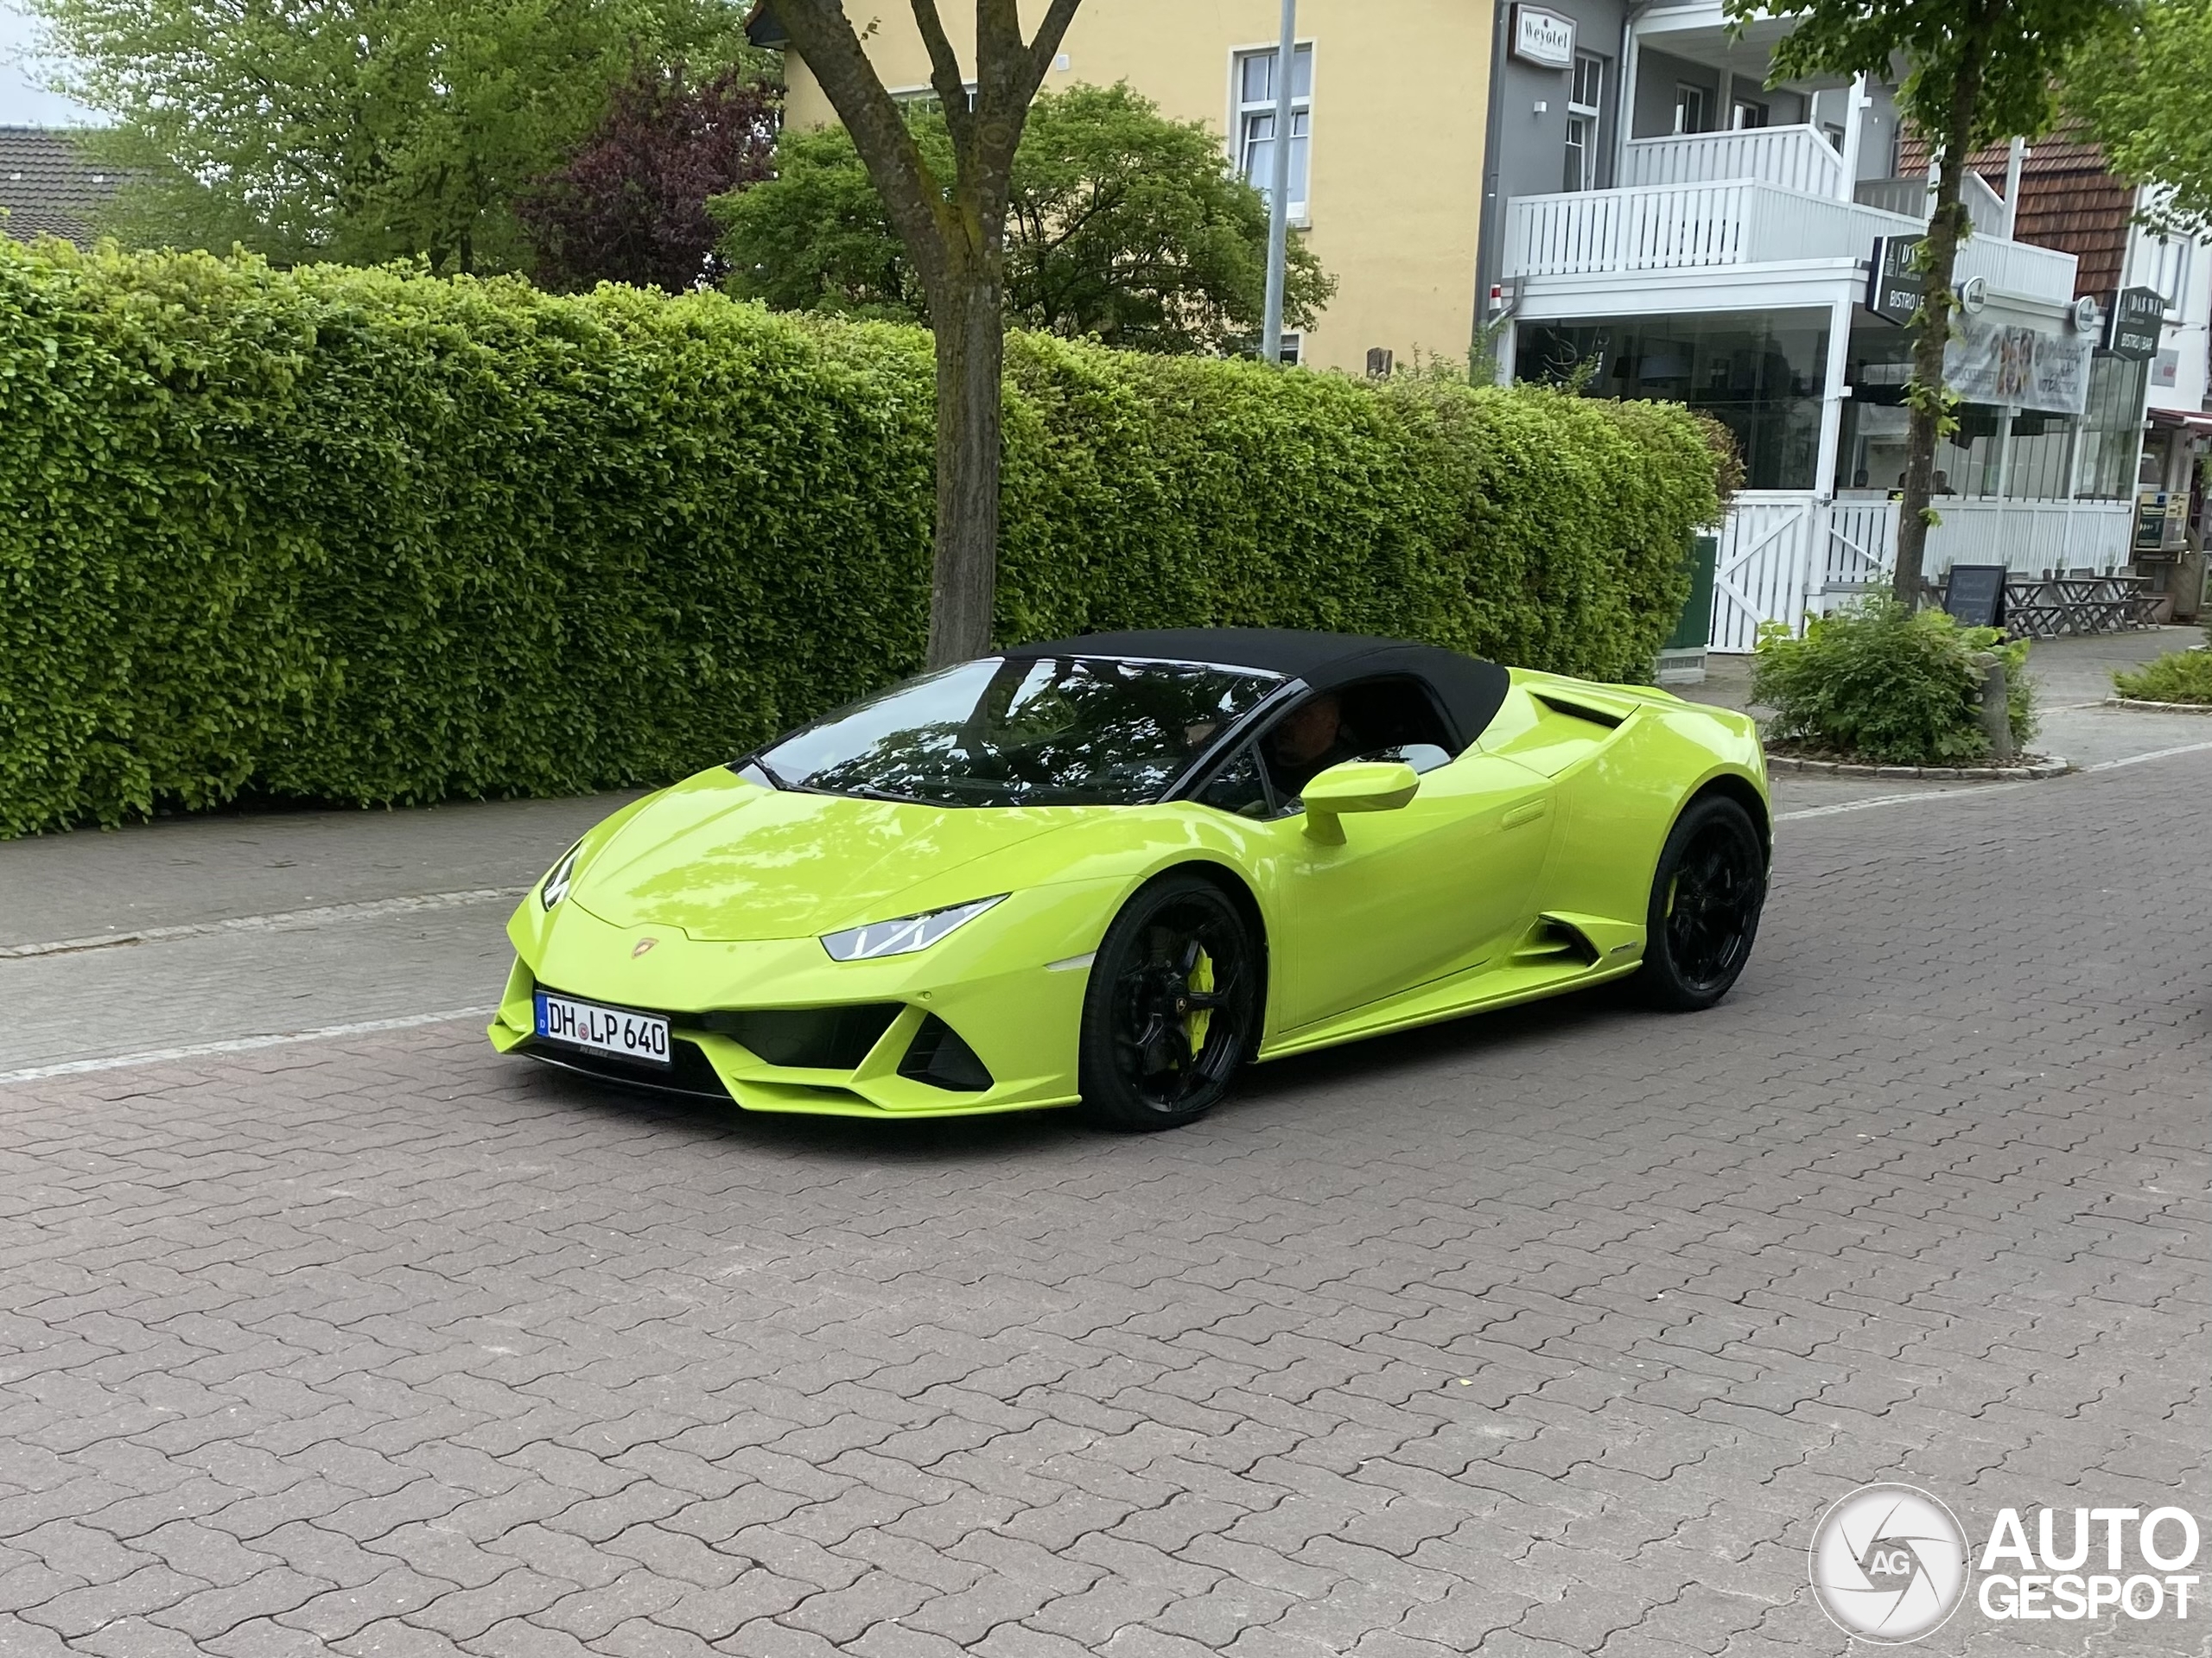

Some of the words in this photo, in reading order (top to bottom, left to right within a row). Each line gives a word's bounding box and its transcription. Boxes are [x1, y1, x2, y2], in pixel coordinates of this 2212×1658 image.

[1525, 21, 1567, 48] Weyotel
[1889, 289, 1916, 310] BISTRO
[2131, 294, 2146, 313] DAS
[2120, 333, 2139, 350] BISTRO
[2141, 336, 2154, 352] BAR
[539, 1019, 546, 1029] D
[549, 1002, 576, 1038] DH
[589, 1010, 618, 1045] LP
[624, 1018, 666, 1055] 640
